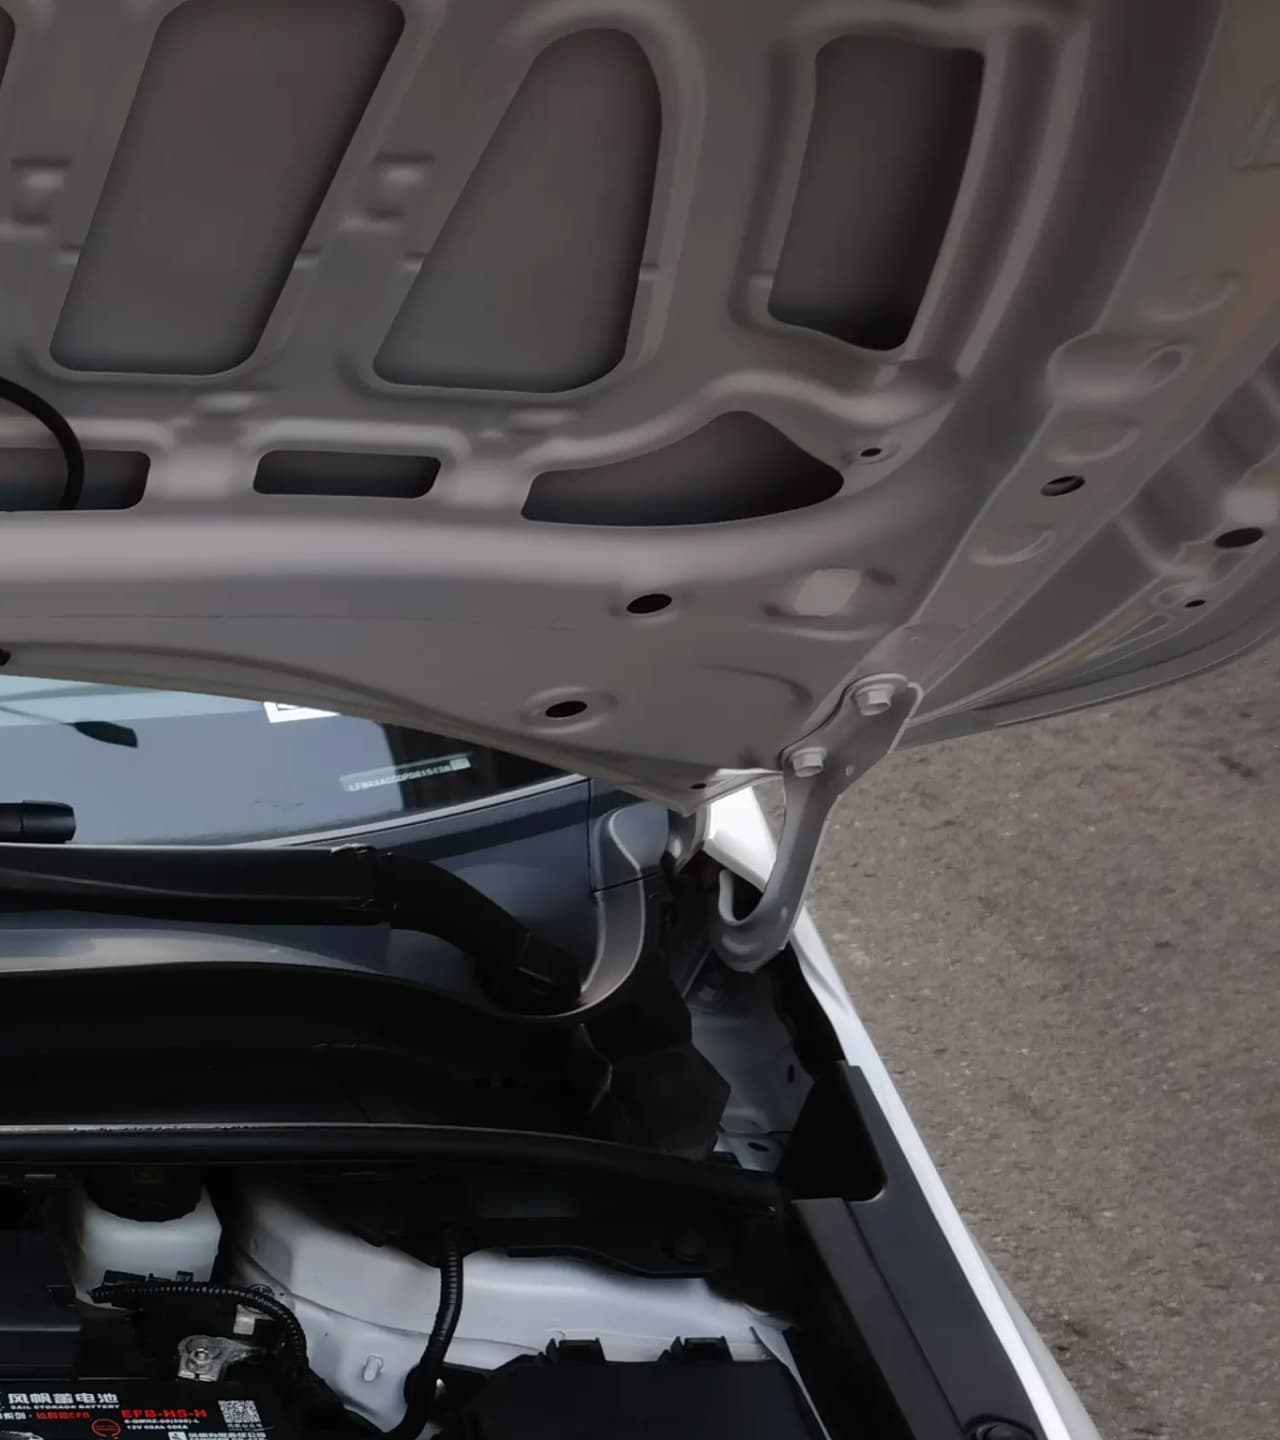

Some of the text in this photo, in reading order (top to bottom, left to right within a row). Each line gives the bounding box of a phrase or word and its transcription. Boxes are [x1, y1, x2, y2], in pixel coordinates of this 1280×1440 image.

[8, 1392, 119, 1404] 风帆蓄电池
